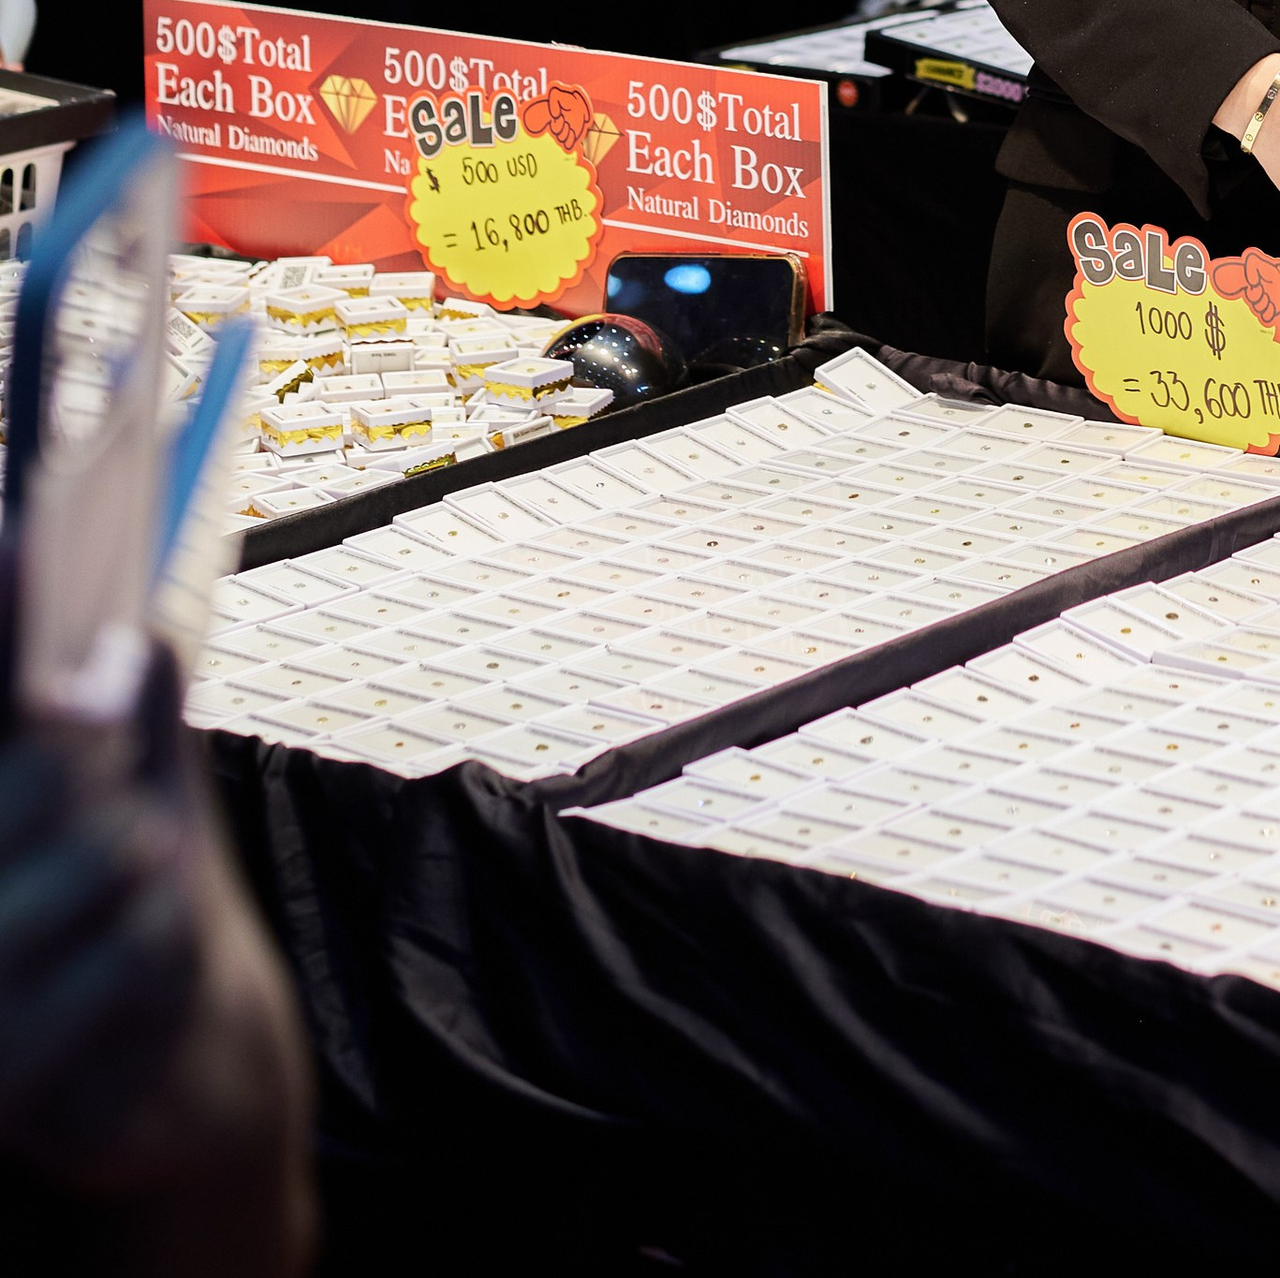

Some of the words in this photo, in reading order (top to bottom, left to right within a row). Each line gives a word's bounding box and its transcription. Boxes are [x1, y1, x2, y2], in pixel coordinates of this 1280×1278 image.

[155, 61, 236, 113] Each
[248, 74, 317, 125] Box
[156, 113, 222, 148] Natural
[228, 125, 319, 162] Diamonds
[462, 156, 499, 186] 500
[506, 153, 538, 179] USD
[625, 129, 715, 184] Each
[731, 145, 807, 199] Box
[470, 209, 550, 253] 16,800
[627, 186, 700, 221] Natural
[708, 198, 809, 239] Diamonds
[1135, 301, 1193, 341] 1000
[1149, 370, 1251, 425] 33,600
